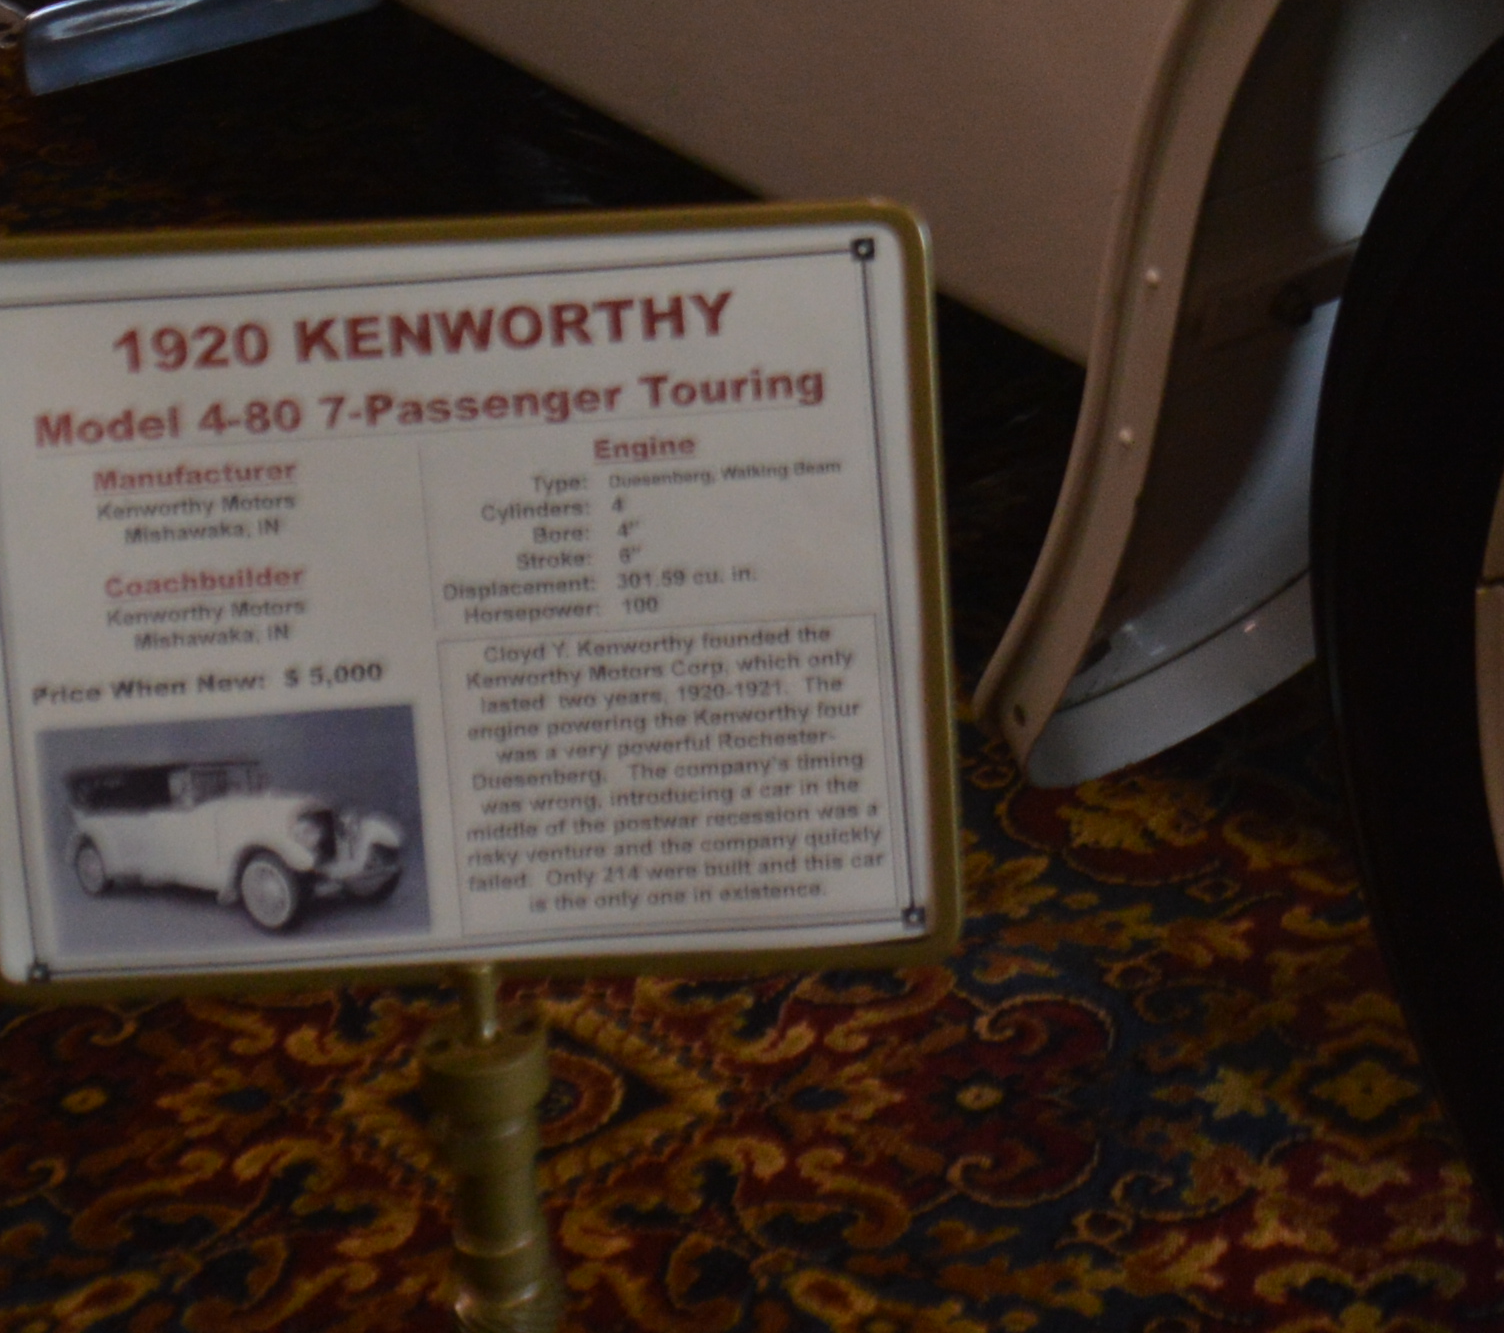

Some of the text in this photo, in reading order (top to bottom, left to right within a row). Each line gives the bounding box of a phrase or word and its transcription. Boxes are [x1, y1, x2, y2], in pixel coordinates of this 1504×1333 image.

[112, 289, 734, 373] 1920 KENWORTHY
[33, 367, 827, 448] Model 4-80 7-Passenger Touring
[592, 434, 698, 460] Engine
[91, 461, 298, 491] Manufacturer
[530, 473, 588, 494] Type:
[719, 461, 792, 480] Walking
[791, 458, 843, 476] Beam
[95, 493, 302, 520] Kenworthy Motors
[479, 494, 627, 525] Cylinders: 4
[257, 517, 283, 536] IN
[532, 525, 591, 543] Bore:
[515, 550, 593, 570] Stroke:
[102, 564, 307, 598] Coachbuilder
[441, 573, 596, 601] Displacement:
[105, 599, 309, 627] Kenworthy Motors
[463, 595, 660, 624] Horsepower: 100
[266, 622, 294, 641] IN
[482, 642, 547, 661] Cloyd
[576, 631, 695, 655] Kenworthy
[700, 625, 792, 648] founded
[796, 624, 832, 642] the
[31, 660, 388, 704] Price When New: $ 5,000
[464, 664, 582, 689] Kenworthy
[588, 662, 664, 681] Motors
[738, 651, 801, 671] which
[806, 646, 856, 670] only
[479, 692, 547, 713] lasted
[557, 690, 599, 708] two
[804, 675, 844, 691] The
[465, 698, 863, 742] engine powering the Kenworthy four
[497, 747, 538, 762] was
[566, 743, 610, 760] very
[616, 734, 711, 758] powerful
[717, 728, 833, 747] Rochester-
[629, 761, 668, 778] The
[795, 750, 867, 771] timing
[480, 799, 522, 814] was
[609, 786, 735, 806] introducing
[759, 782, 793, 796] car
[799, 779, 820, 794] in
[825, 775, 862, 793] the
[465, 821, 539, 840] middle
[545, 818, 567, 833] of
[572, 816, 606, 832] the
[612, 813, 699, 834] postwar
[705, 806, 810, 824] recession
[816, 803, 860, 819] was
[466, 825, 882, 866] risky venture and the company quickly
[545, 867, 595, 886] Only
[647, 864, 698, 879] were
[703, 859, 751, 876] built
[760, 855, 798, 873] and
[803, 853, 844, 870] this
[849, 851, 885, 869] car
[528, 897, 548, 912] is
[553, 892, 589, 910] the
[593, 889, 640, 909] only
[646, 889, 687, 905] one
[692, 887, 713, 902] in
